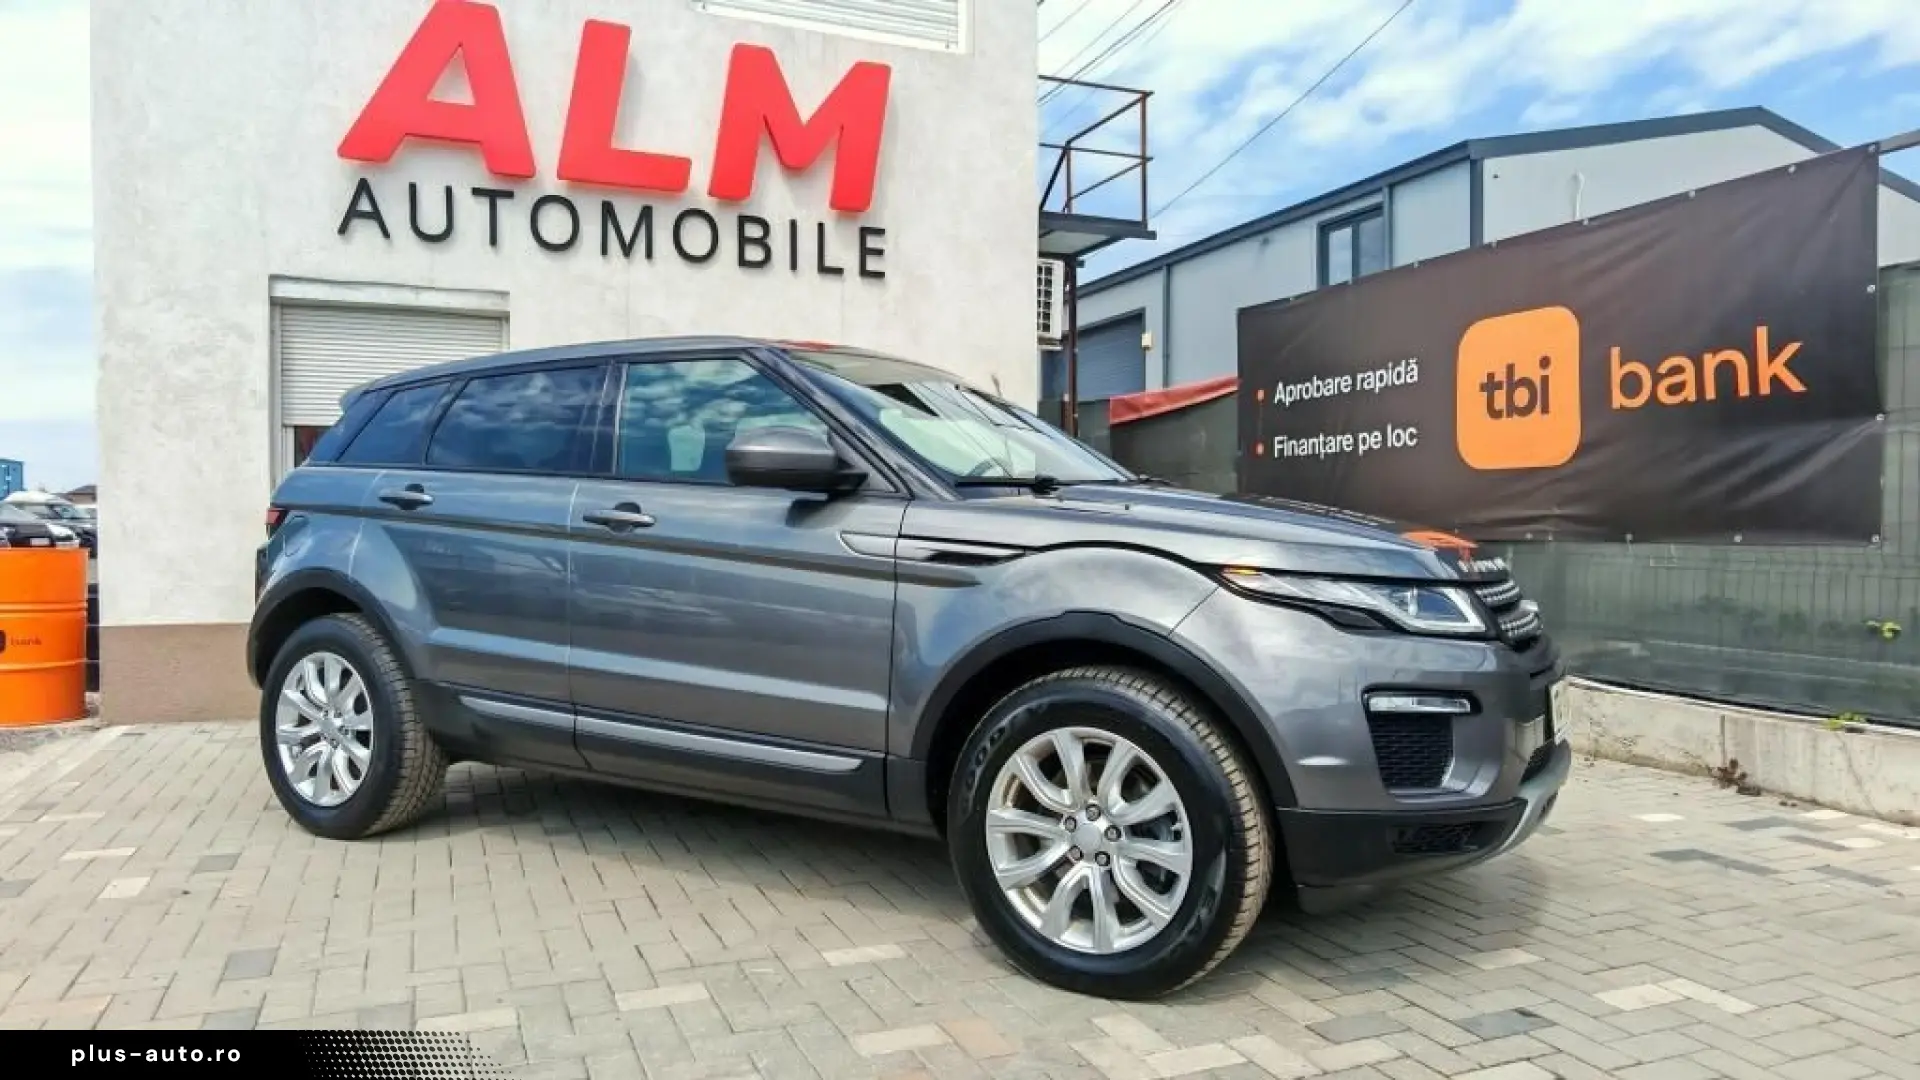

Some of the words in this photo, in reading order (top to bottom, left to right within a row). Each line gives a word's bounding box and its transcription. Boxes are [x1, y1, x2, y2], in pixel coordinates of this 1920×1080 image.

[337, 0, 891, 213] ALM
[338, 177, 886, 279] AUTOMOBILE
[1273, 375, 1353, 408] Aprobare
[1356, 357, 1419, 394] rapidă
[1479, 355, 1551, 420] tbi
[1610, 326, 1806, 410] bank
[1273, 433, 1354, 459] Finanțare
[1358, 431, 1383, 456] pe
[1386, 423, 1419, 448] loc
